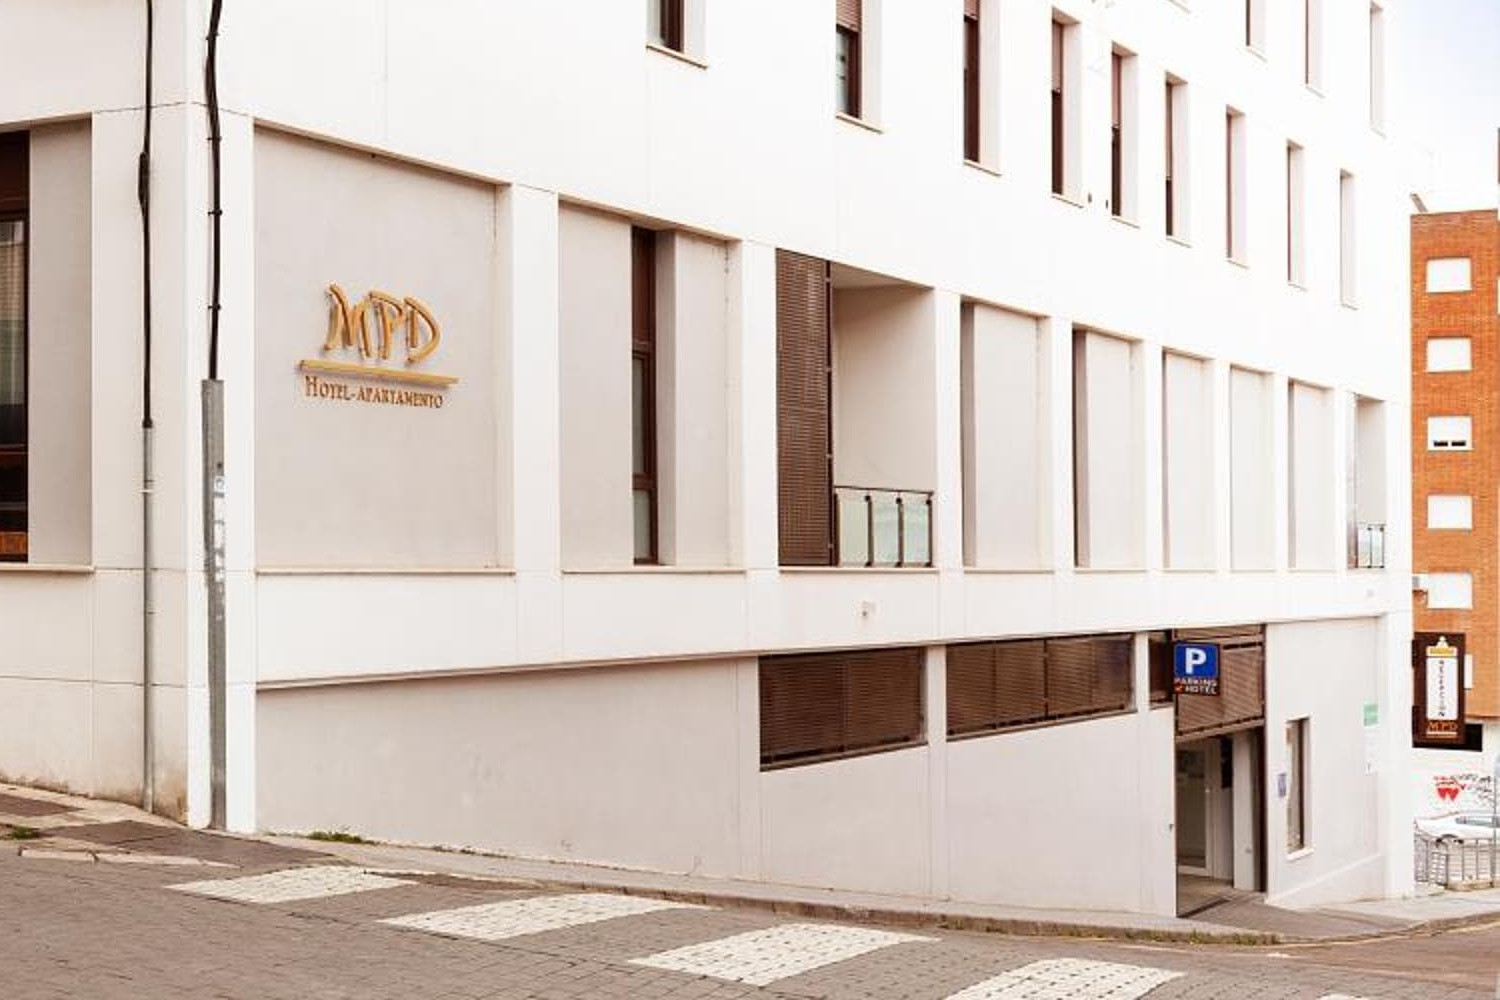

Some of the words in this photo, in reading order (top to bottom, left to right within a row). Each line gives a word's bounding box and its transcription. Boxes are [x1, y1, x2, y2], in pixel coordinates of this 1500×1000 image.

[323, 284, 441, 364] MPD
[1185, 647, 1207, 675] P
[1185, 685, 1218, 695] HOTEL
